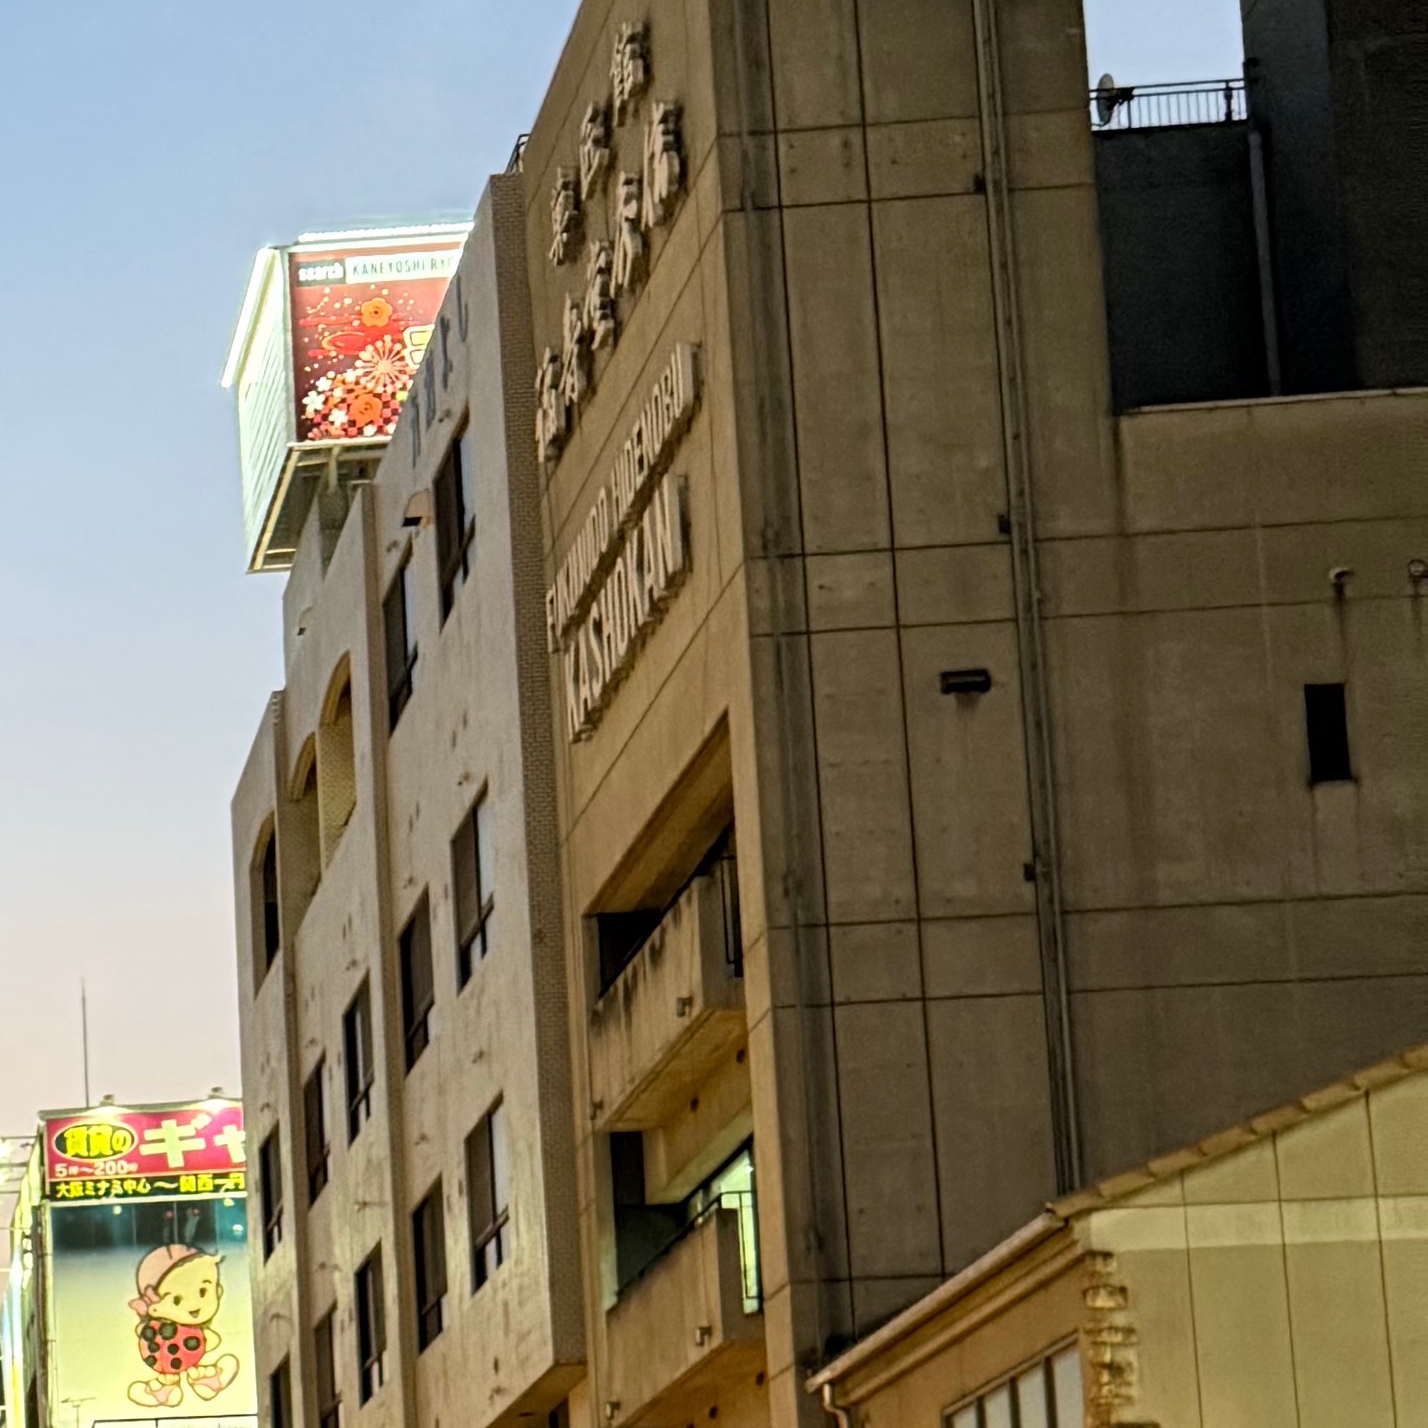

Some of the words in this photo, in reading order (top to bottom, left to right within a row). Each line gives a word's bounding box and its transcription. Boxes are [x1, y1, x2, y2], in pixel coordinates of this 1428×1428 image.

[352, 258, 425, 276] KANEYOSHI
[430, 256, 453, 270] RY
[564, 474, 685, 742] KASHOKAN
